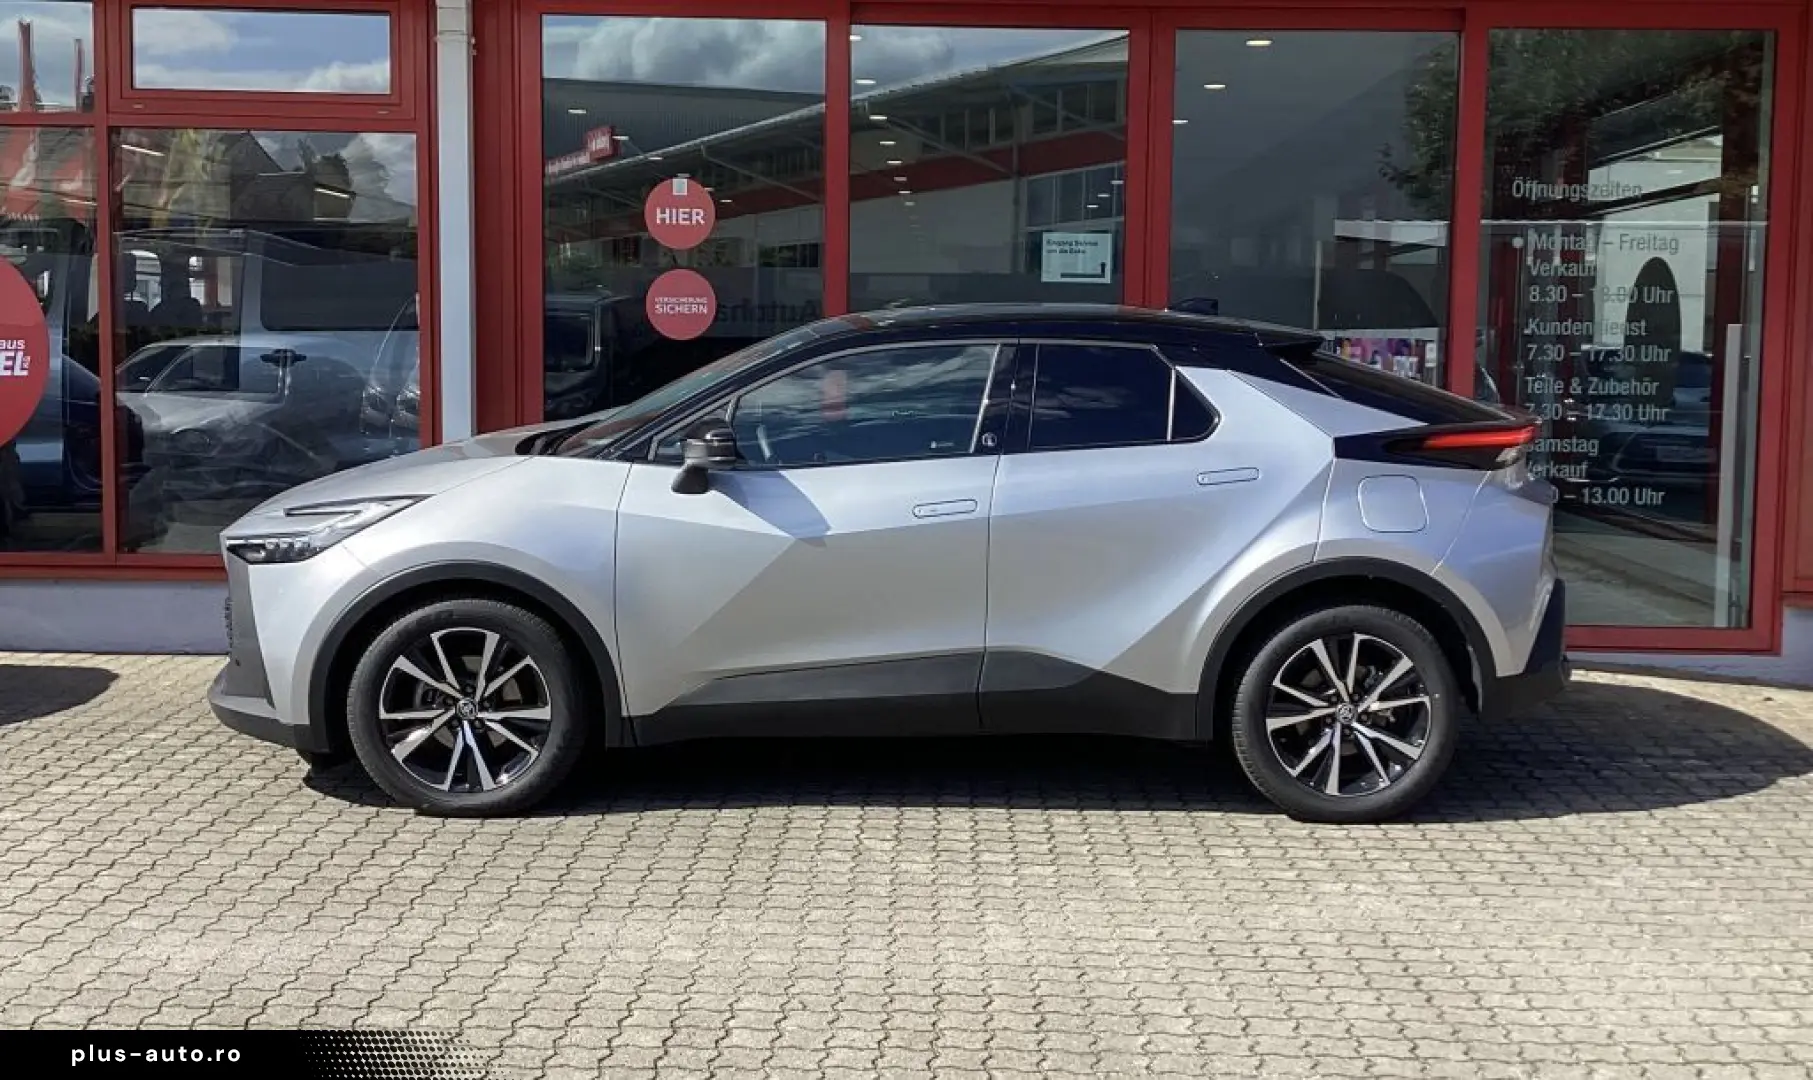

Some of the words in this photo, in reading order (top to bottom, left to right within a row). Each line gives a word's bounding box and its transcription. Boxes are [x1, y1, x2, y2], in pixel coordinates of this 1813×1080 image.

[1511, 176, 1643, 203] Öffnungszeiten
[656, 208, 705, 225] HIER
[1530, 232, 1598, 253] Montag
[1619, 233, 1679, 255] Freitag
[1529, 258, 1597, 277] Verkauf
[1529, 285, 1567, 302] 8.30
[1590, 286, 1639, 303] 8.00
[1644, 286, 1675, 303] Uhr
[654, 304, 708, 314] SICHERN
[1528, 318, 1648, 335] Kundendienst
[1526, 345, 1565, 361] 7.30
[1587, 345, 1635, 361] 17.30
[1641, 345, 1672, 361] Uhr
[1525, 376, 1564, 394] Teile
[1569, 377, 1583, 394] &
[1588, 376, 1660, 396] Zubehör
[1525, 403, 1563, 420] 730
[1587, 403, 1632, 420] 17.30
[1638, 403, 1668, 421] Uhr
[1583, 487, 1629, 504] 13.00
[1635, 487, 1666, 504] Uhr
